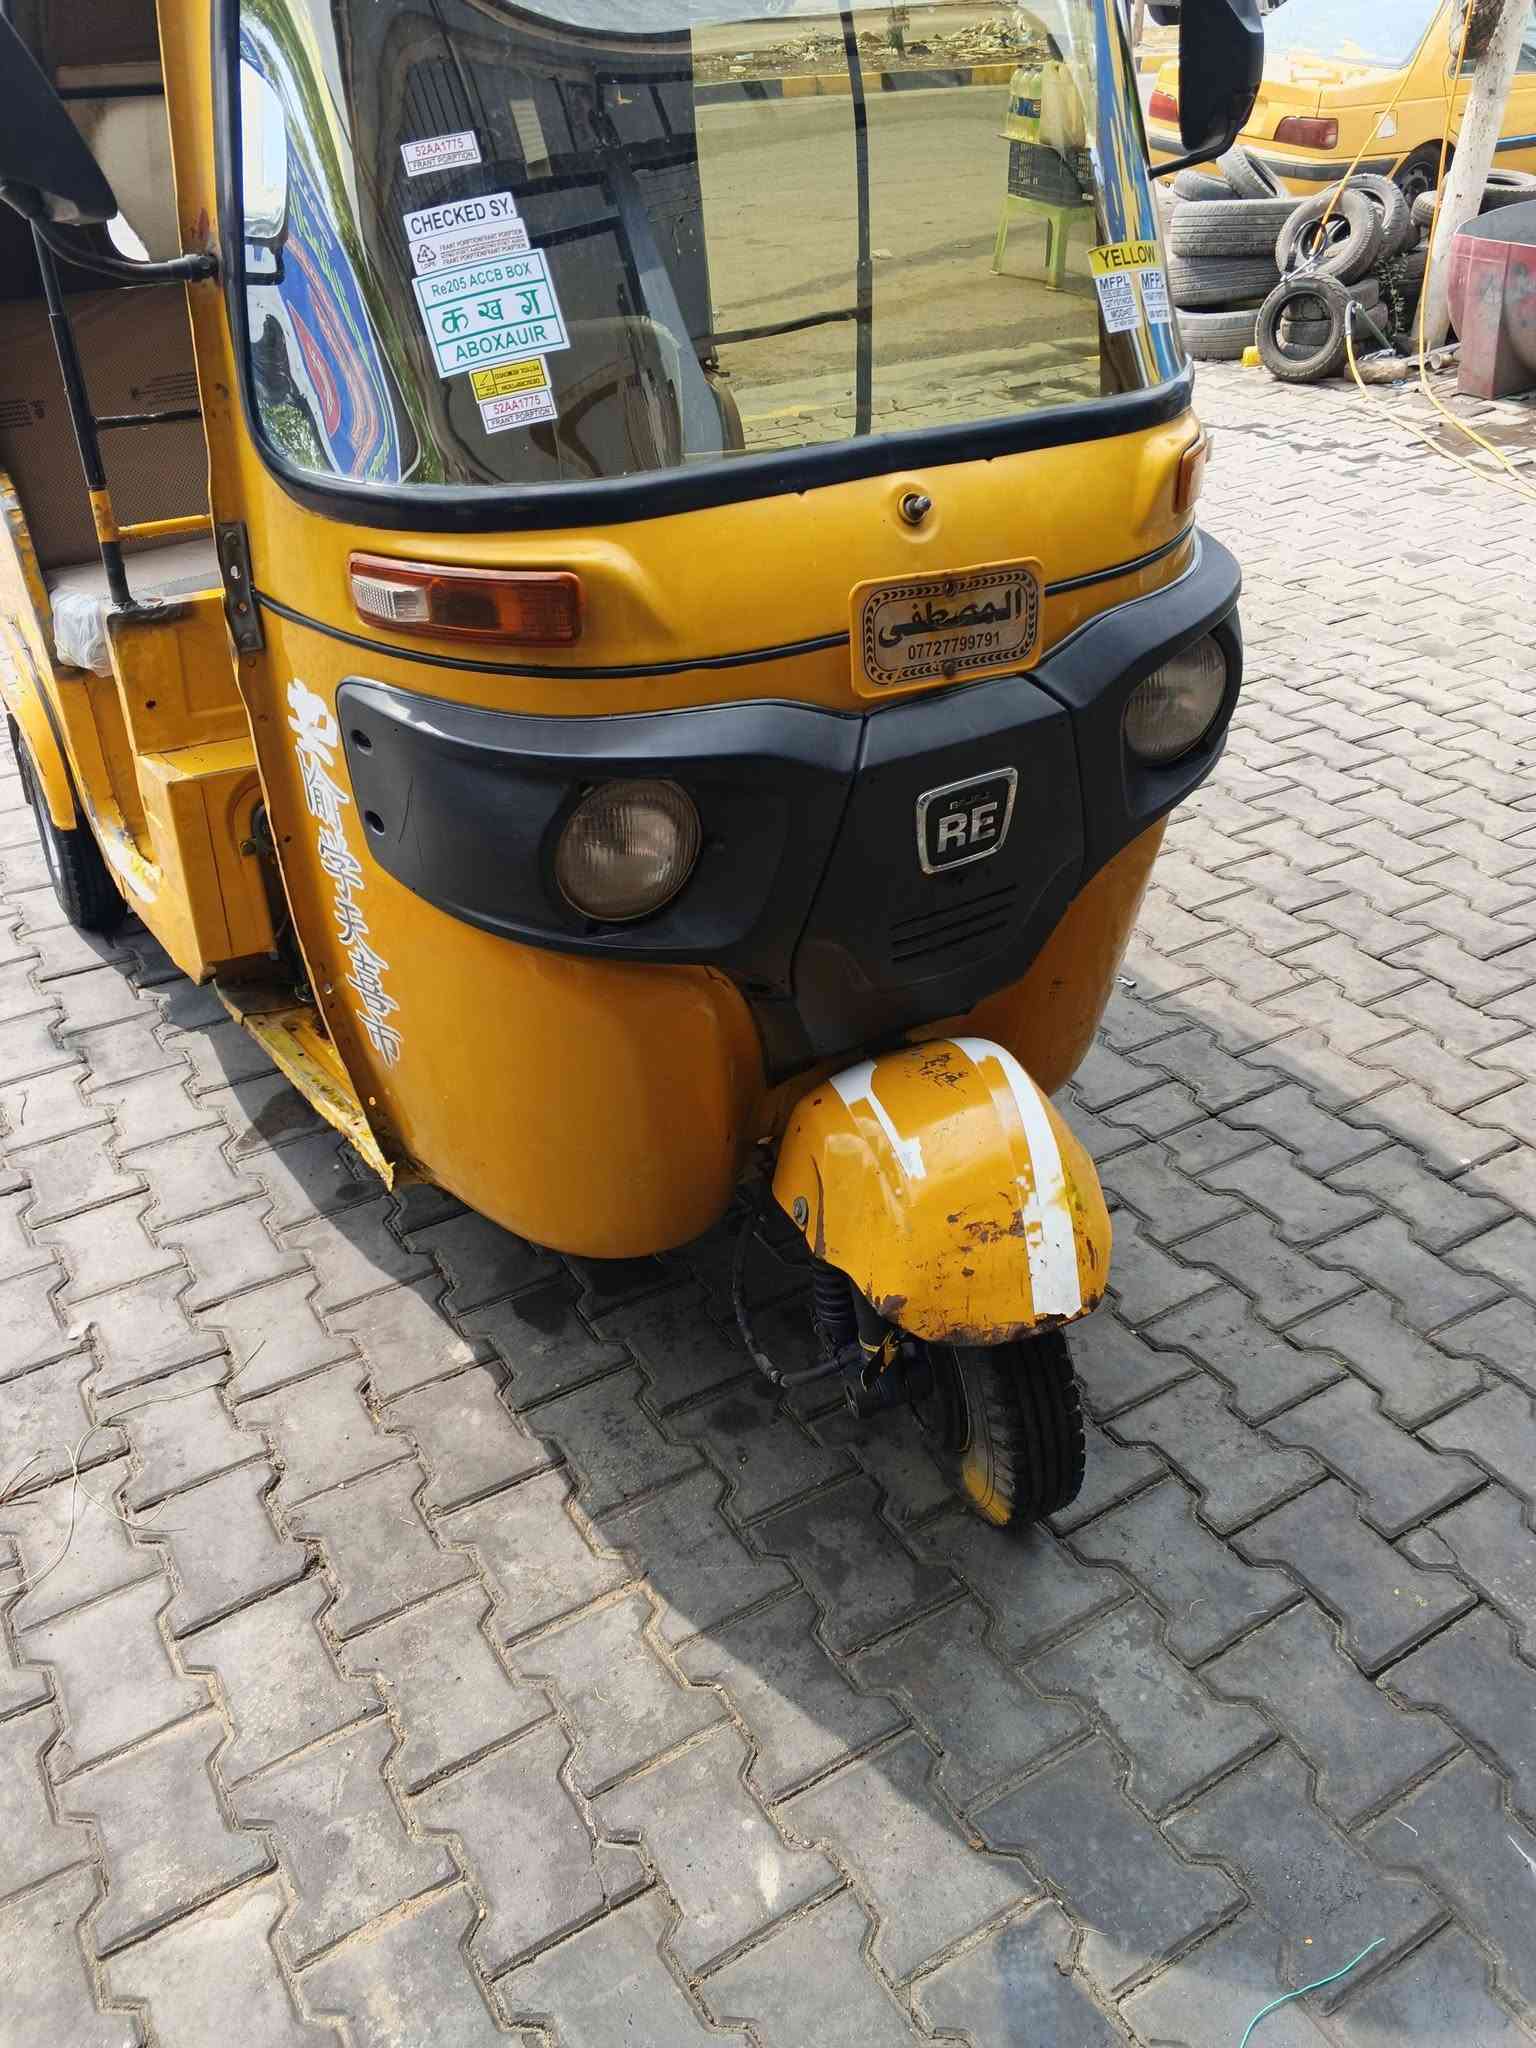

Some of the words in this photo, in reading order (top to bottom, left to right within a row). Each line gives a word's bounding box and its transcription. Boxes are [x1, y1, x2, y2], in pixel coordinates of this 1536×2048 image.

[410, 203, 486, 235] CHECKED
[491, 197, 515, 218] SY.
[1099, 245, 1156, 269] YELLOW
[431, 279, 467, 297] Re205
[470, 268, 503, 287] ACCB
[507, 263, 532, 279] BOX
[1099, 274, 1130, 289] MFPL
[442, 307, 469, 335] क
[477, 298, 504, 321] ख
[516, 288, 541, 316] ग
[456, 325, 549, 362] ABOXAUIR
[494, 394, 542, 414] 52AA1775
[878, 587, 1022, 648] المصطفى
[908, 631, 1001, 660] 07727799791
[938, 801, 998, 853] RE
